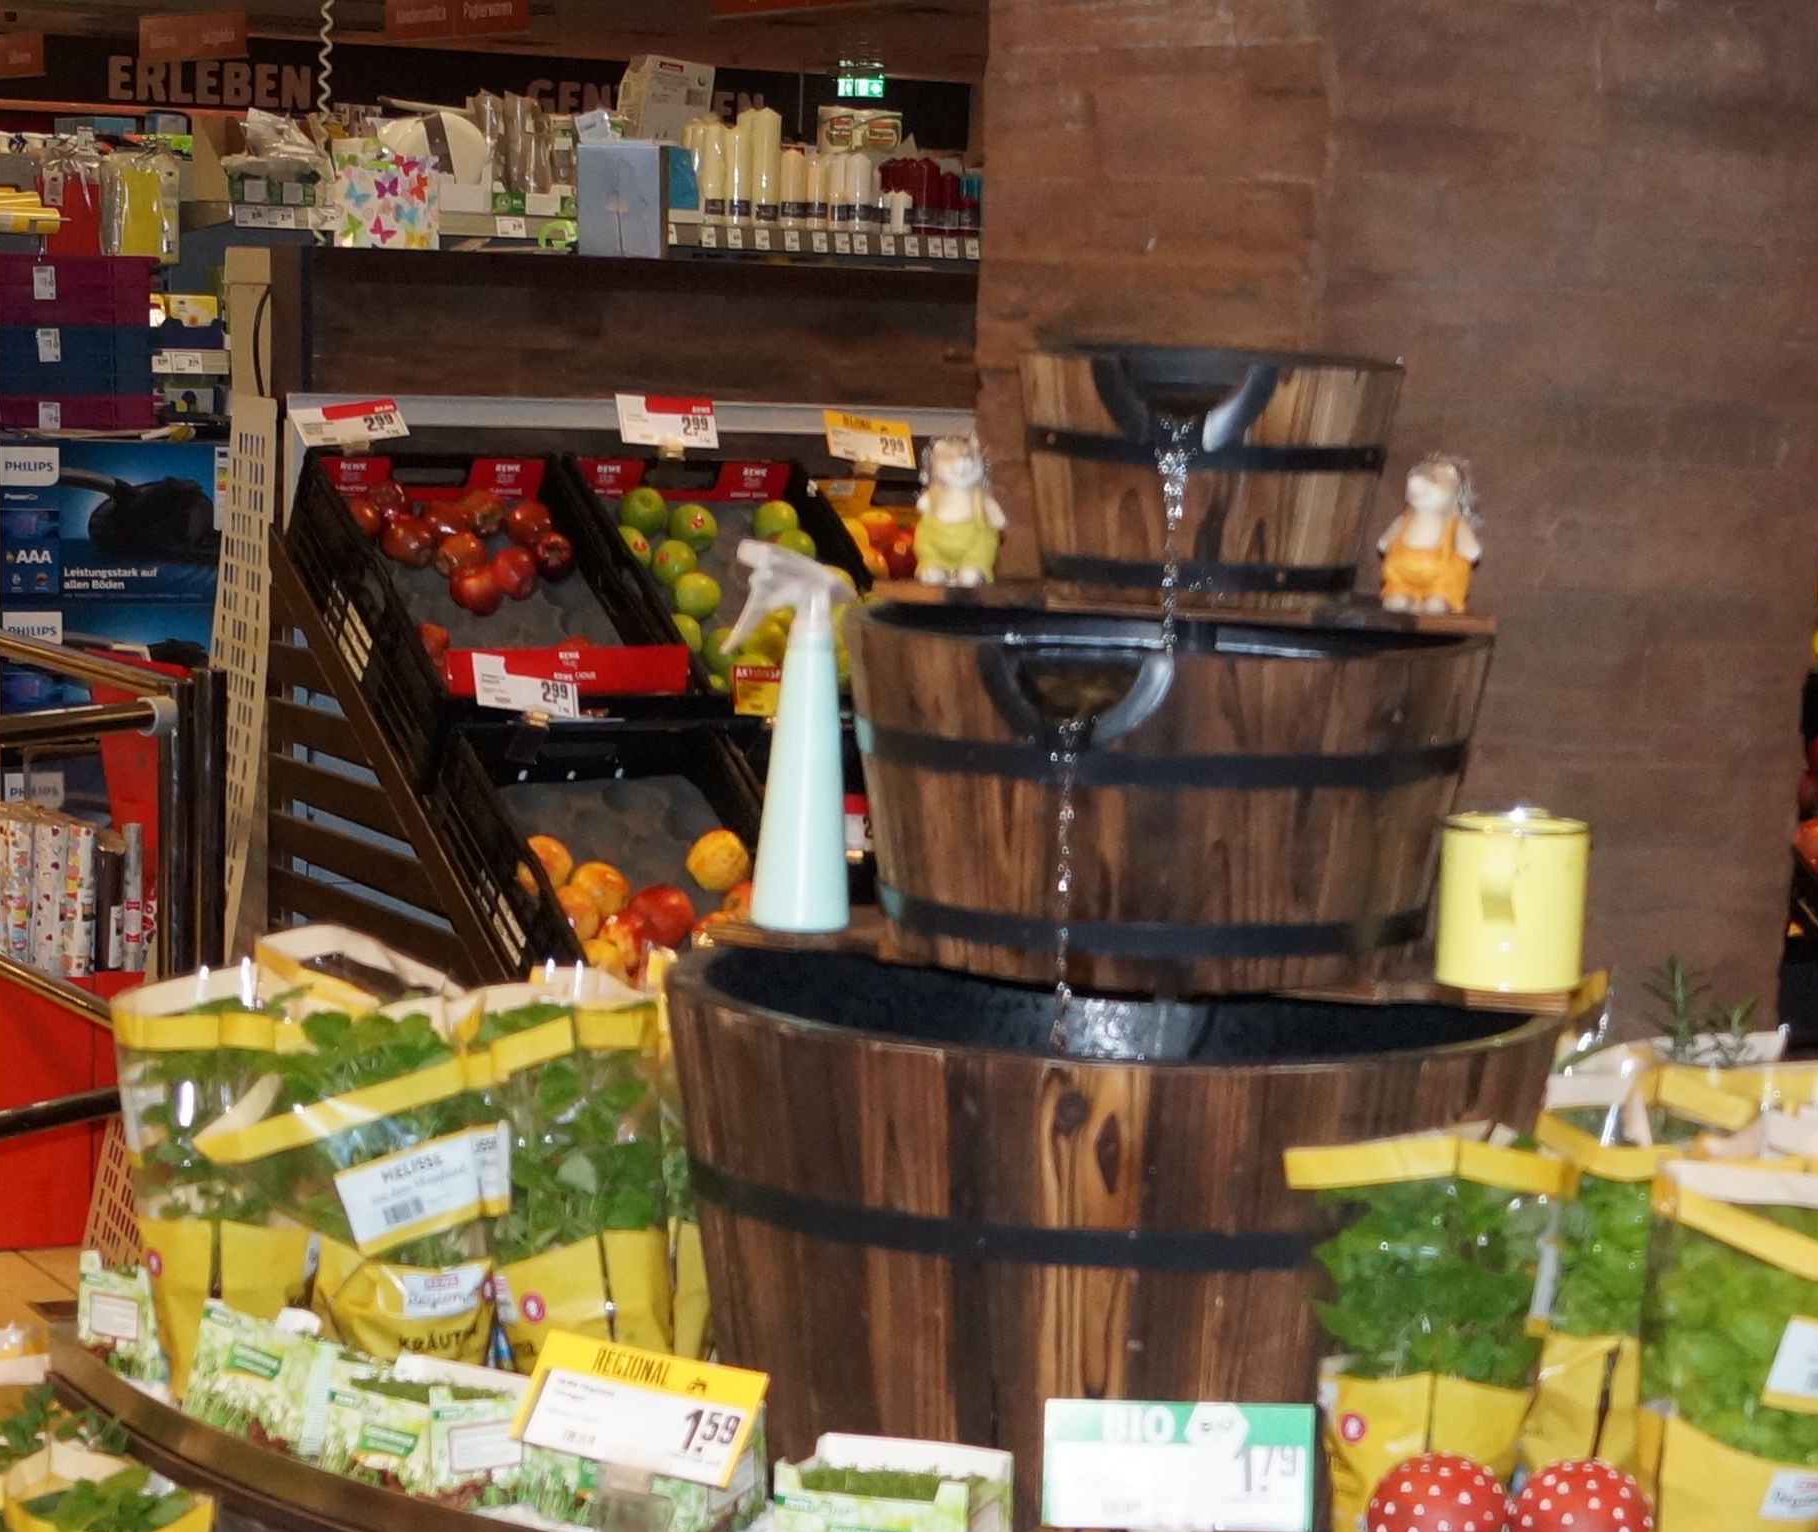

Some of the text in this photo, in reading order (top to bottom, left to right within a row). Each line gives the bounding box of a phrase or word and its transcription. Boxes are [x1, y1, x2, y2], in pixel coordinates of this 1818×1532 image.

[108, 55, 310, 110] ERLEBEN
[363, 413, 395, 432] 2.99
[681, 415, 709, 437] 2.99
[5, 460, 54, 472] PHILIPS
[339, 461, 367, 472] REWE
[494, 462, 521, 474] REWE
[596, 463, 622, 474] REWE
[742, 467, 768, 478] REWE
[16, 549, 53, 565] AAA
[64, 566, 158, 580] Leistungsstark auf
[64, 579, 125, 590] allen Böden
[7, 625, 58, 637] PHILIPS
[540, 681, 569, 704] 2.99
[382, 1151, 446, 1184] MELISSE
[591, 1346, 672, 1387] REGIONAL
[682, 1408, 742, 1455] 1.59
[1100, 1404, 1175, 1443] BIO
[1232, 1445, 1298, 1495] 1.79
